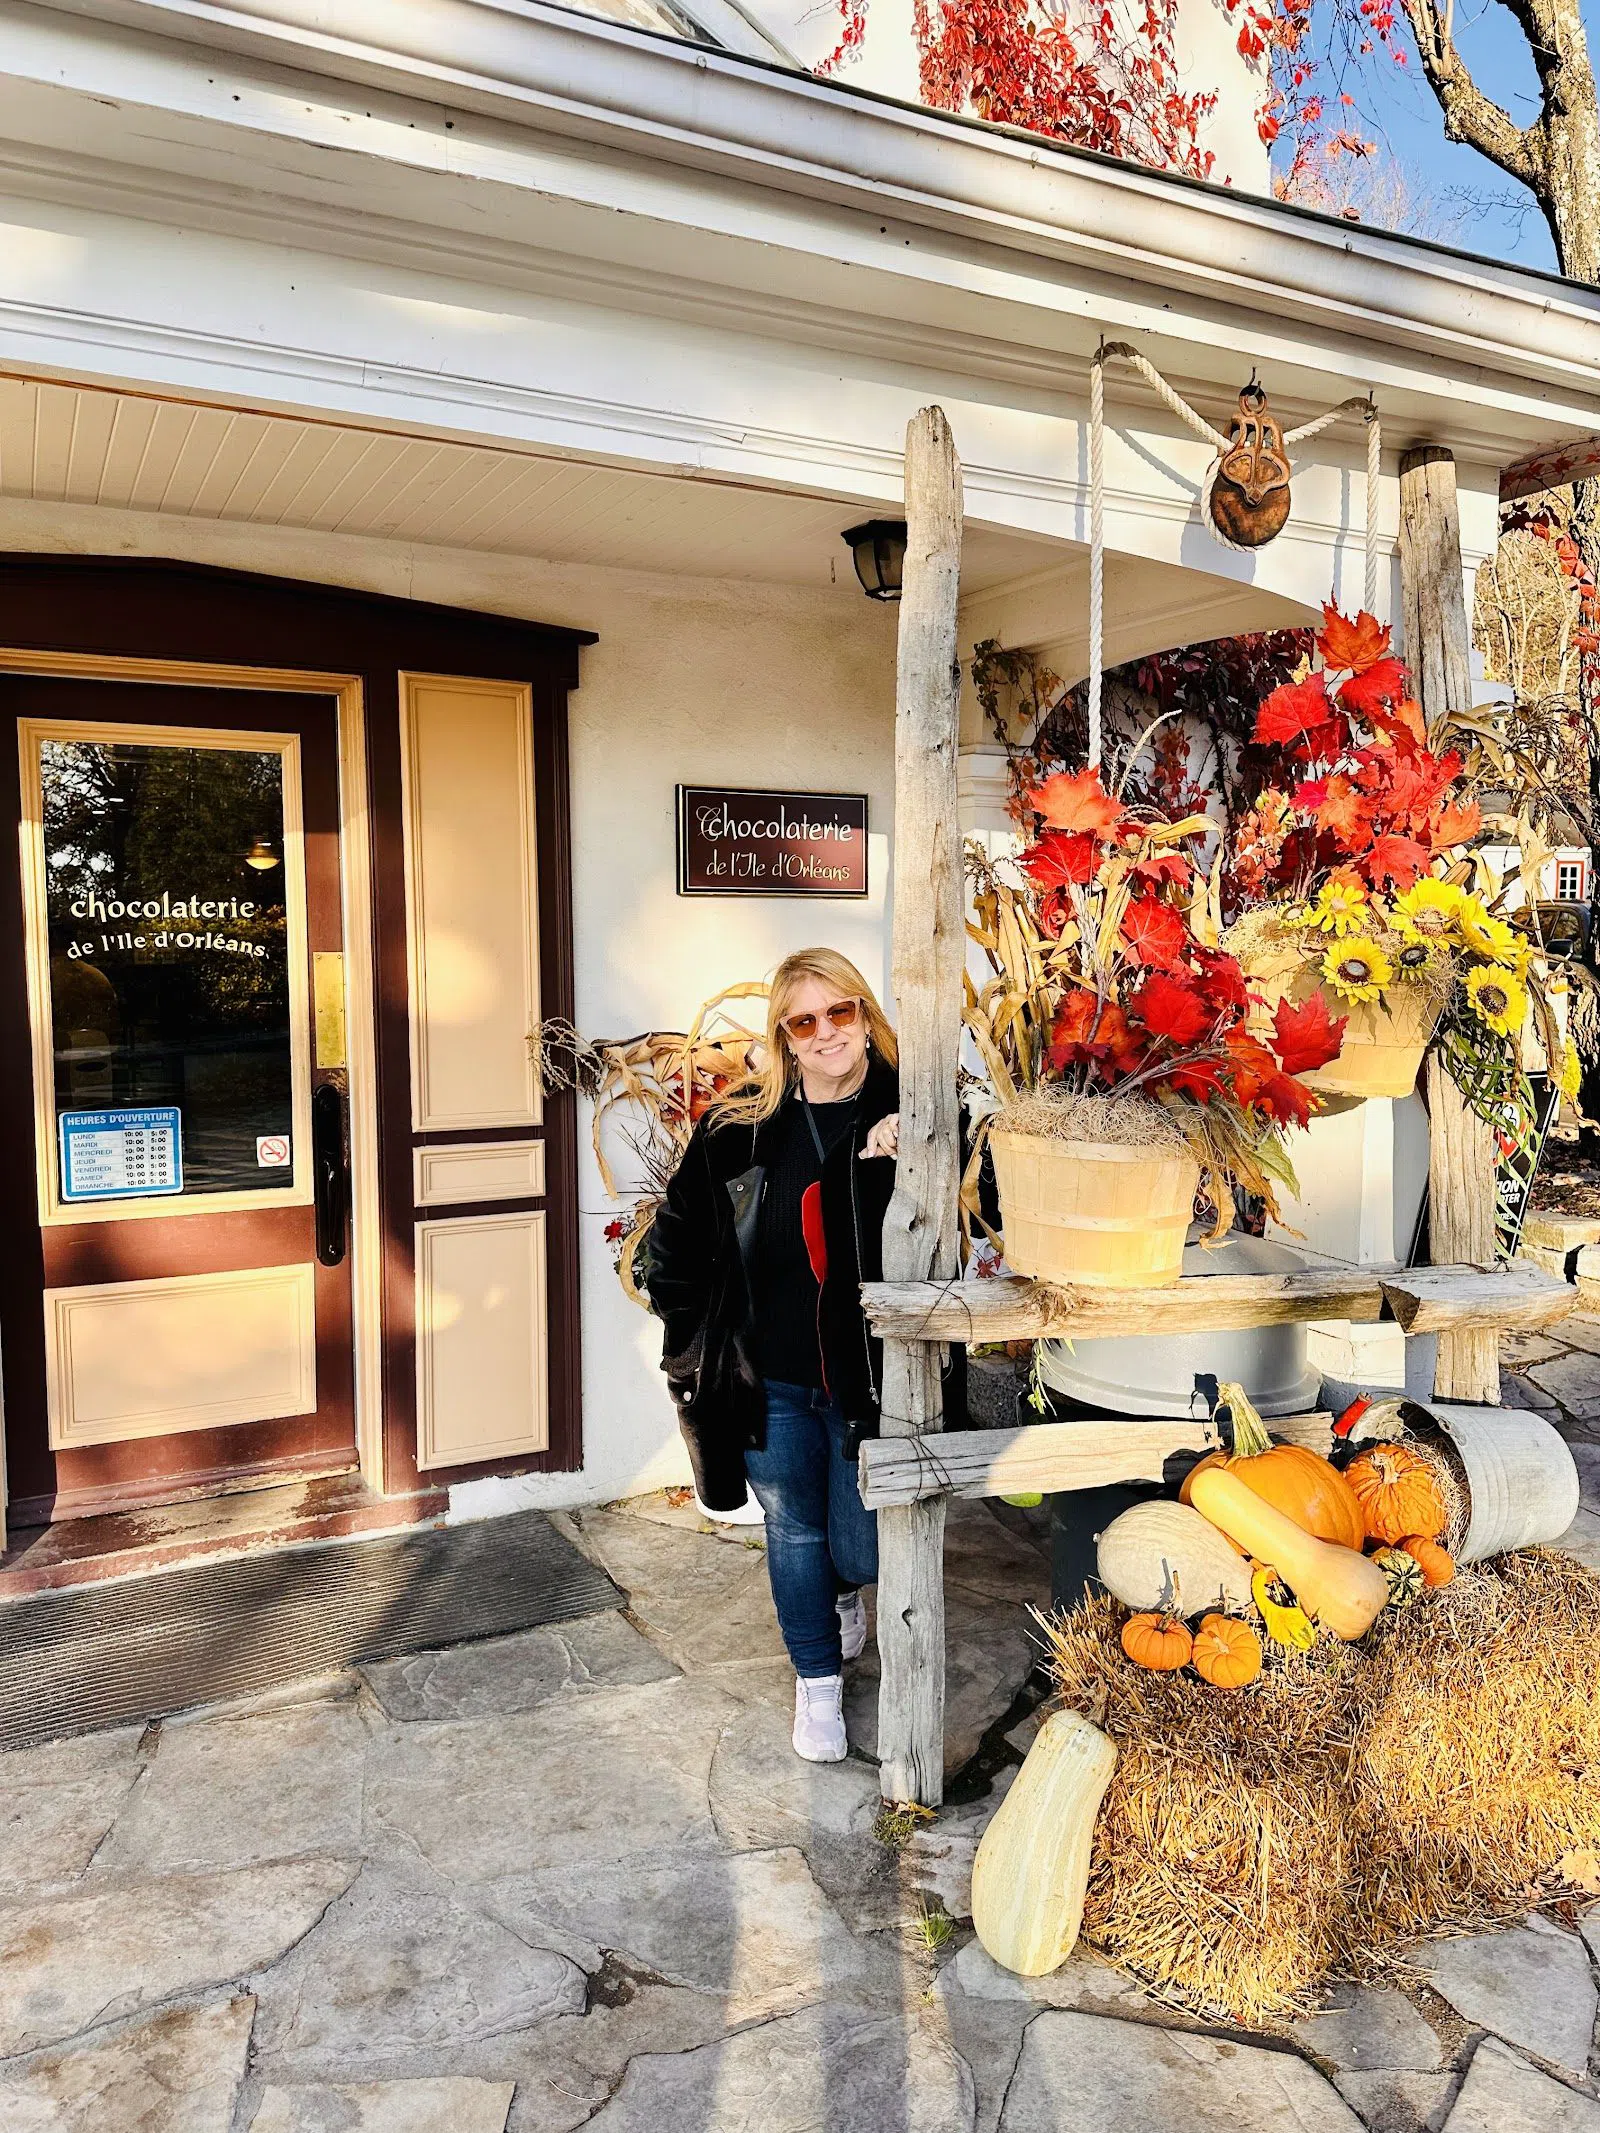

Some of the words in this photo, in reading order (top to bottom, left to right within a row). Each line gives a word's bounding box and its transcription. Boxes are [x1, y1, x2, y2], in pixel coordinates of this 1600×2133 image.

[695, 801, 853, 842] Chocolaterie
[706, 849, 727, 876] de
[771, 852, 850, 881] d'Orléans
[70, 891, 255, 923] chocolaterie
[67, 941, 95, 959] de
[67, 1115, 107, 1126] HEURES
[109, 1111, 175, 1124] D'OUVERTURE
[74, 1149, 113, 1157] MERCREDI
[75, 1174, 103, 1182] SAMEDI
[1497, 1180, 1520, 1194] ION
